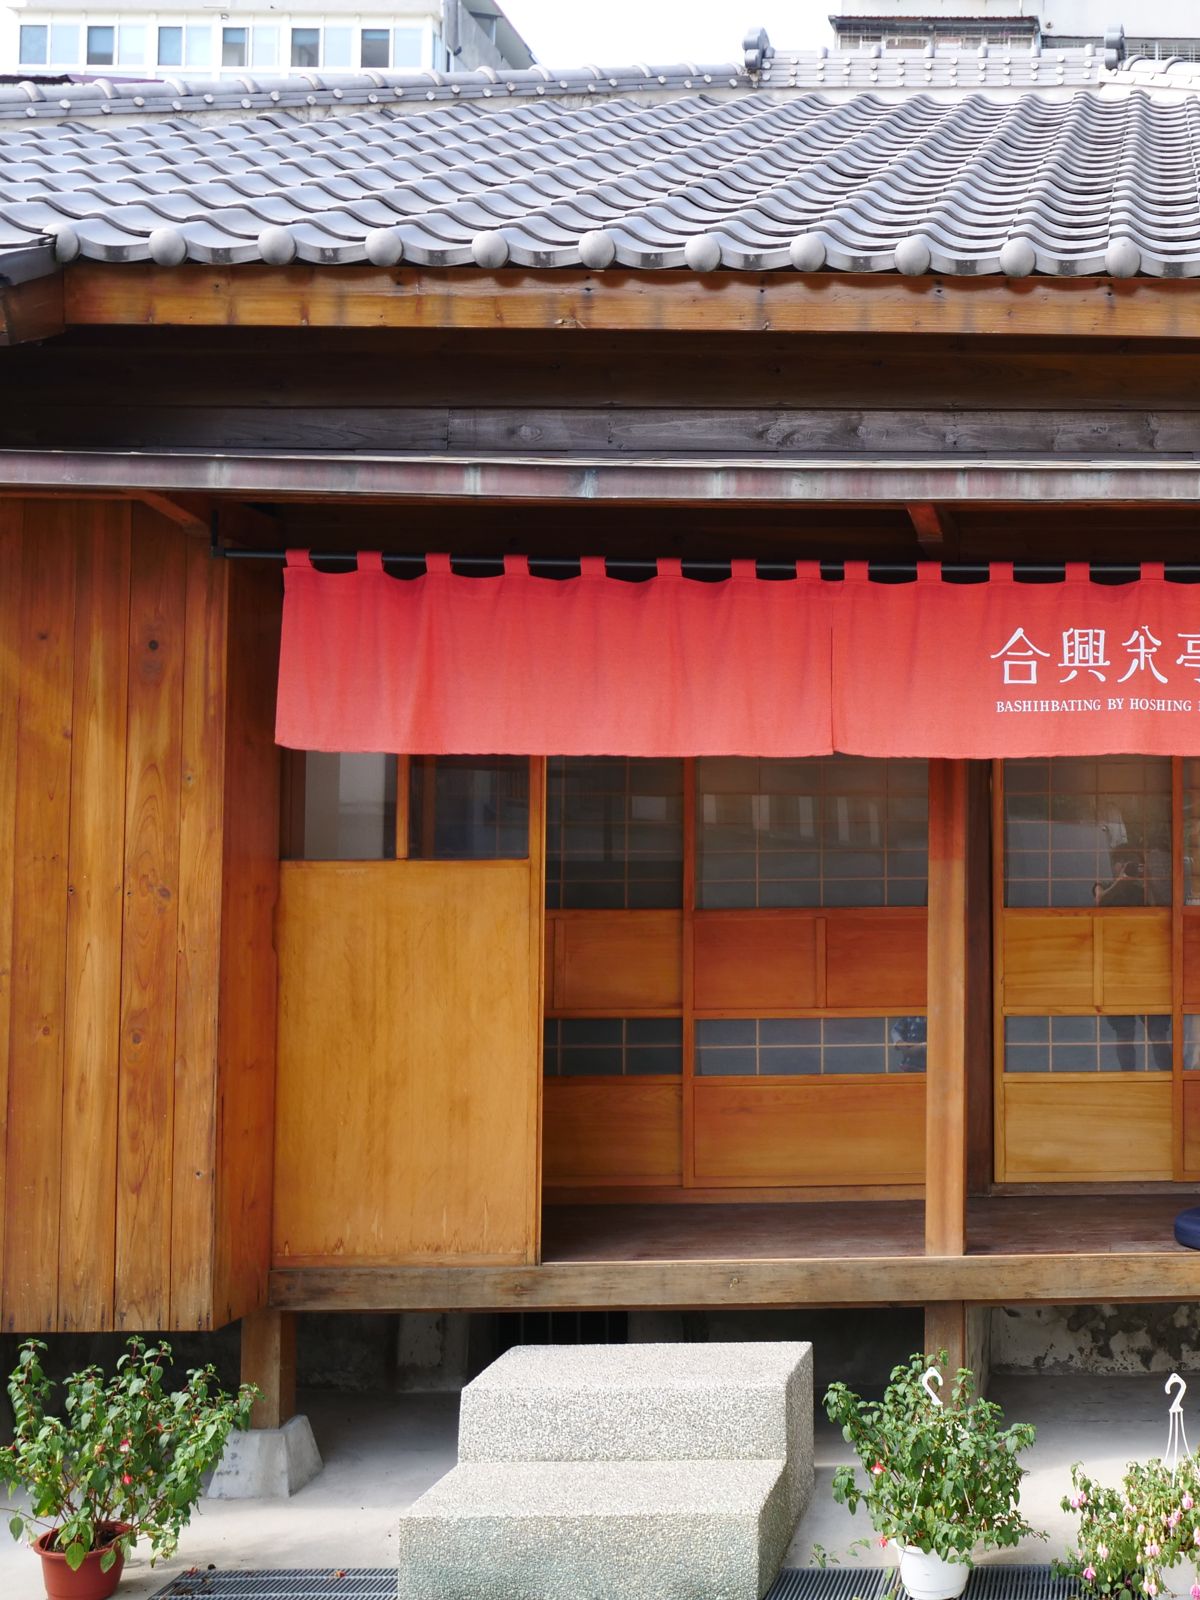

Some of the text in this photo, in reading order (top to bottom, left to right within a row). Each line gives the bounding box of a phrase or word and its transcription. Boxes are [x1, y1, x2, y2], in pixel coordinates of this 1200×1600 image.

[996, 699, 1101, 713] BASHIHBATING
[1107, 698, 1125, 710] BY
[1129, 698, 1192, 712] HOSHING
